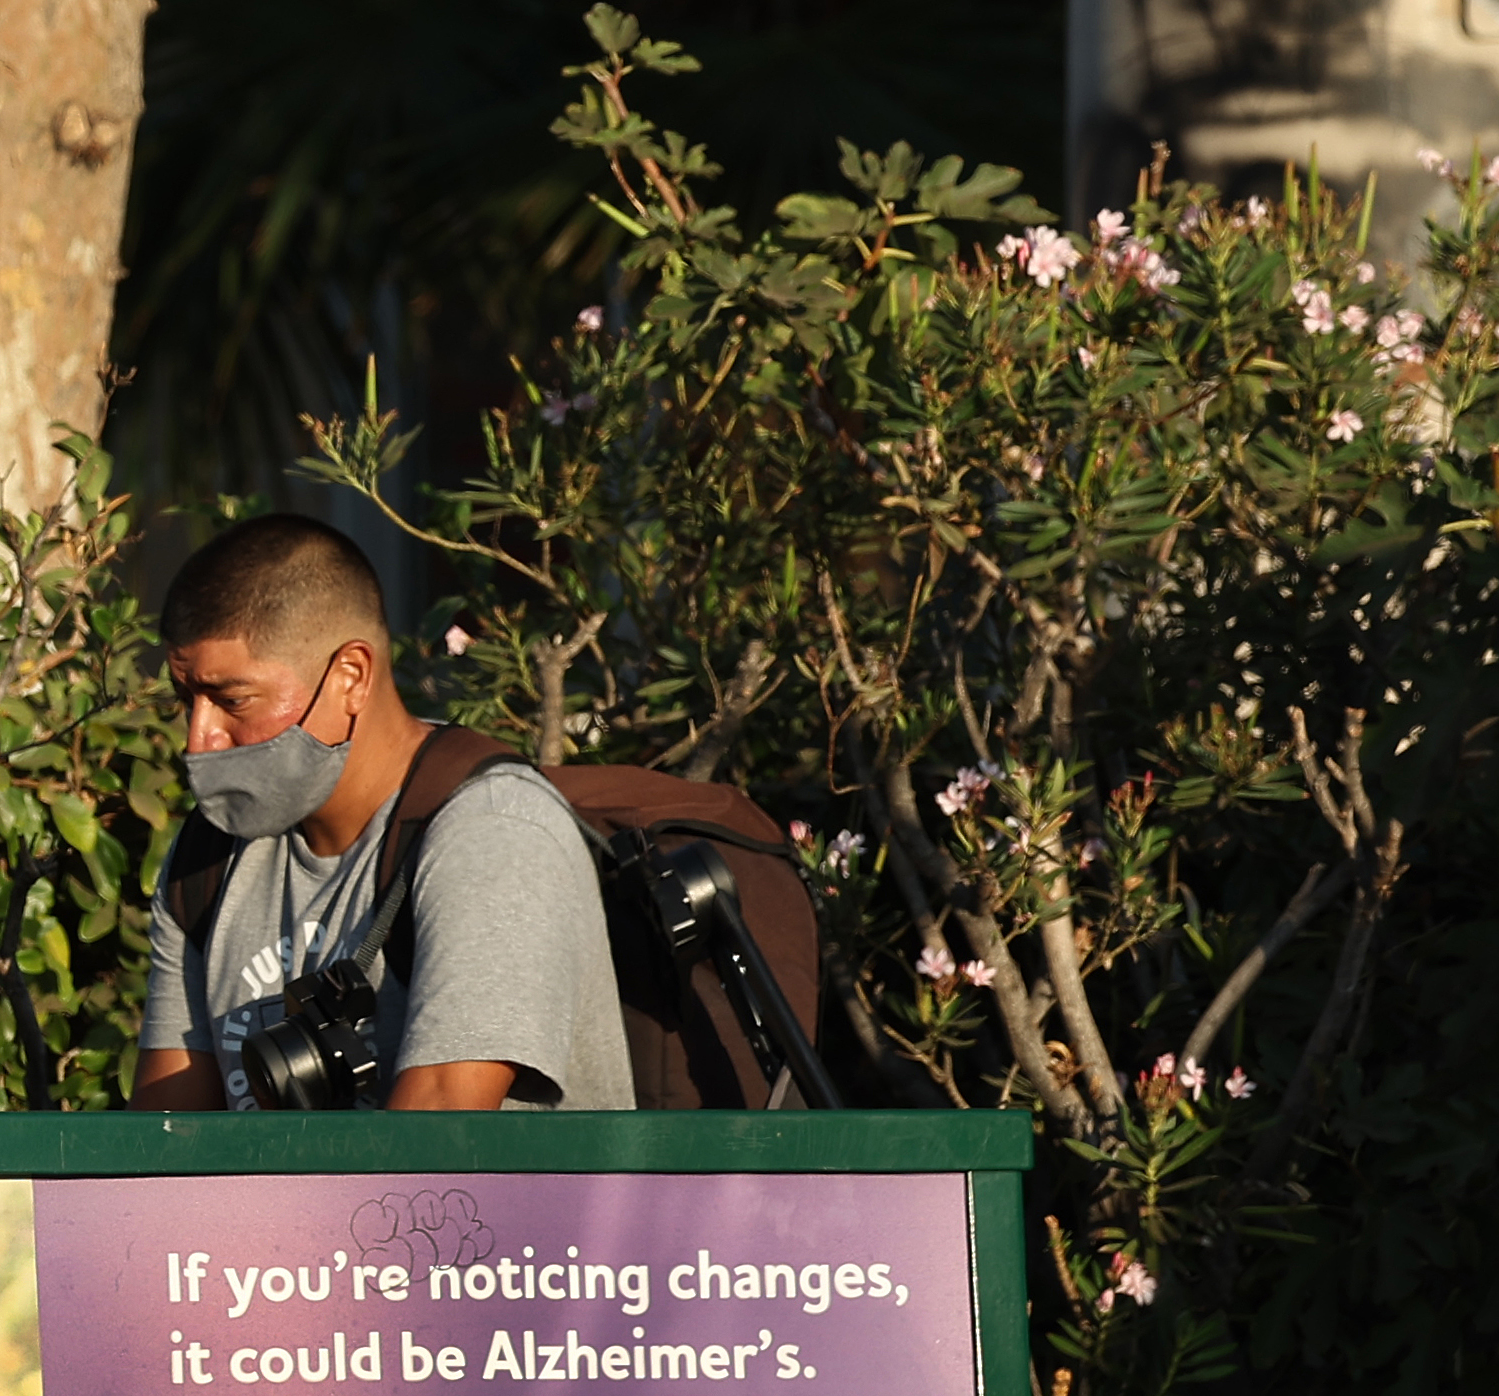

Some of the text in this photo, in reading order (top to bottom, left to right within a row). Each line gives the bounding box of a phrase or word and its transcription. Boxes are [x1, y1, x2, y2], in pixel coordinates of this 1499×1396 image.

[167, 1245, 910, 1319] If you're noticing changes,
[170, 1326, 818, 1385] it could be Alzheimer's.
